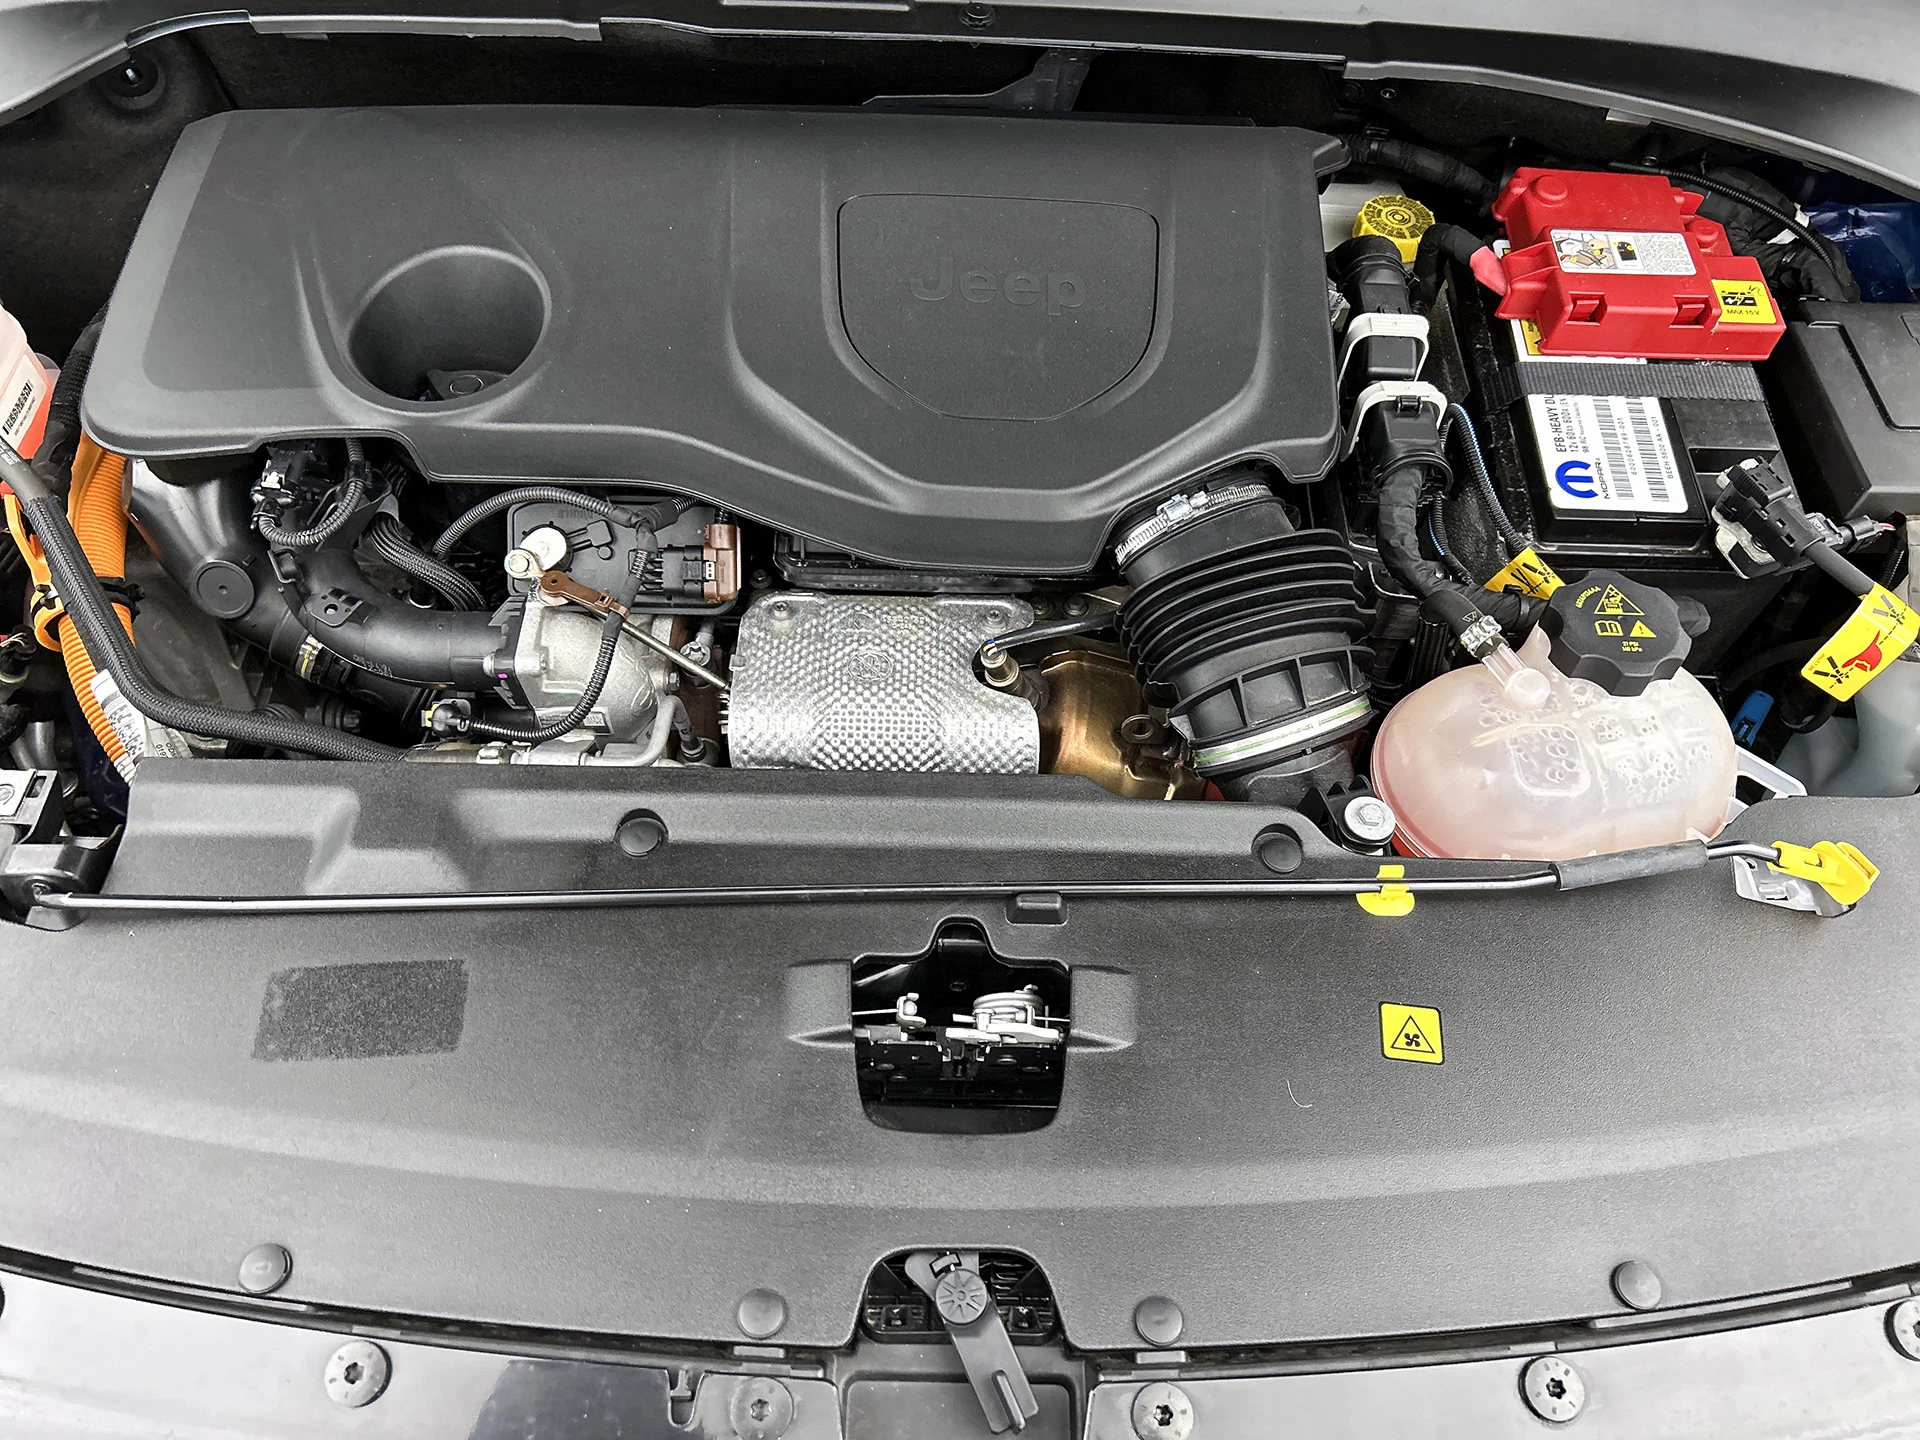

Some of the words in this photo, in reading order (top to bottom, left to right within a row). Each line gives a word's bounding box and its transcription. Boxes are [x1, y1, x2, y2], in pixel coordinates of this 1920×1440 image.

[909, 256, 1087, 316] Jeep
[1726, 308, 1744, 316] MAX
[1546, 406, 1567, 452] EFB-HEAVY
